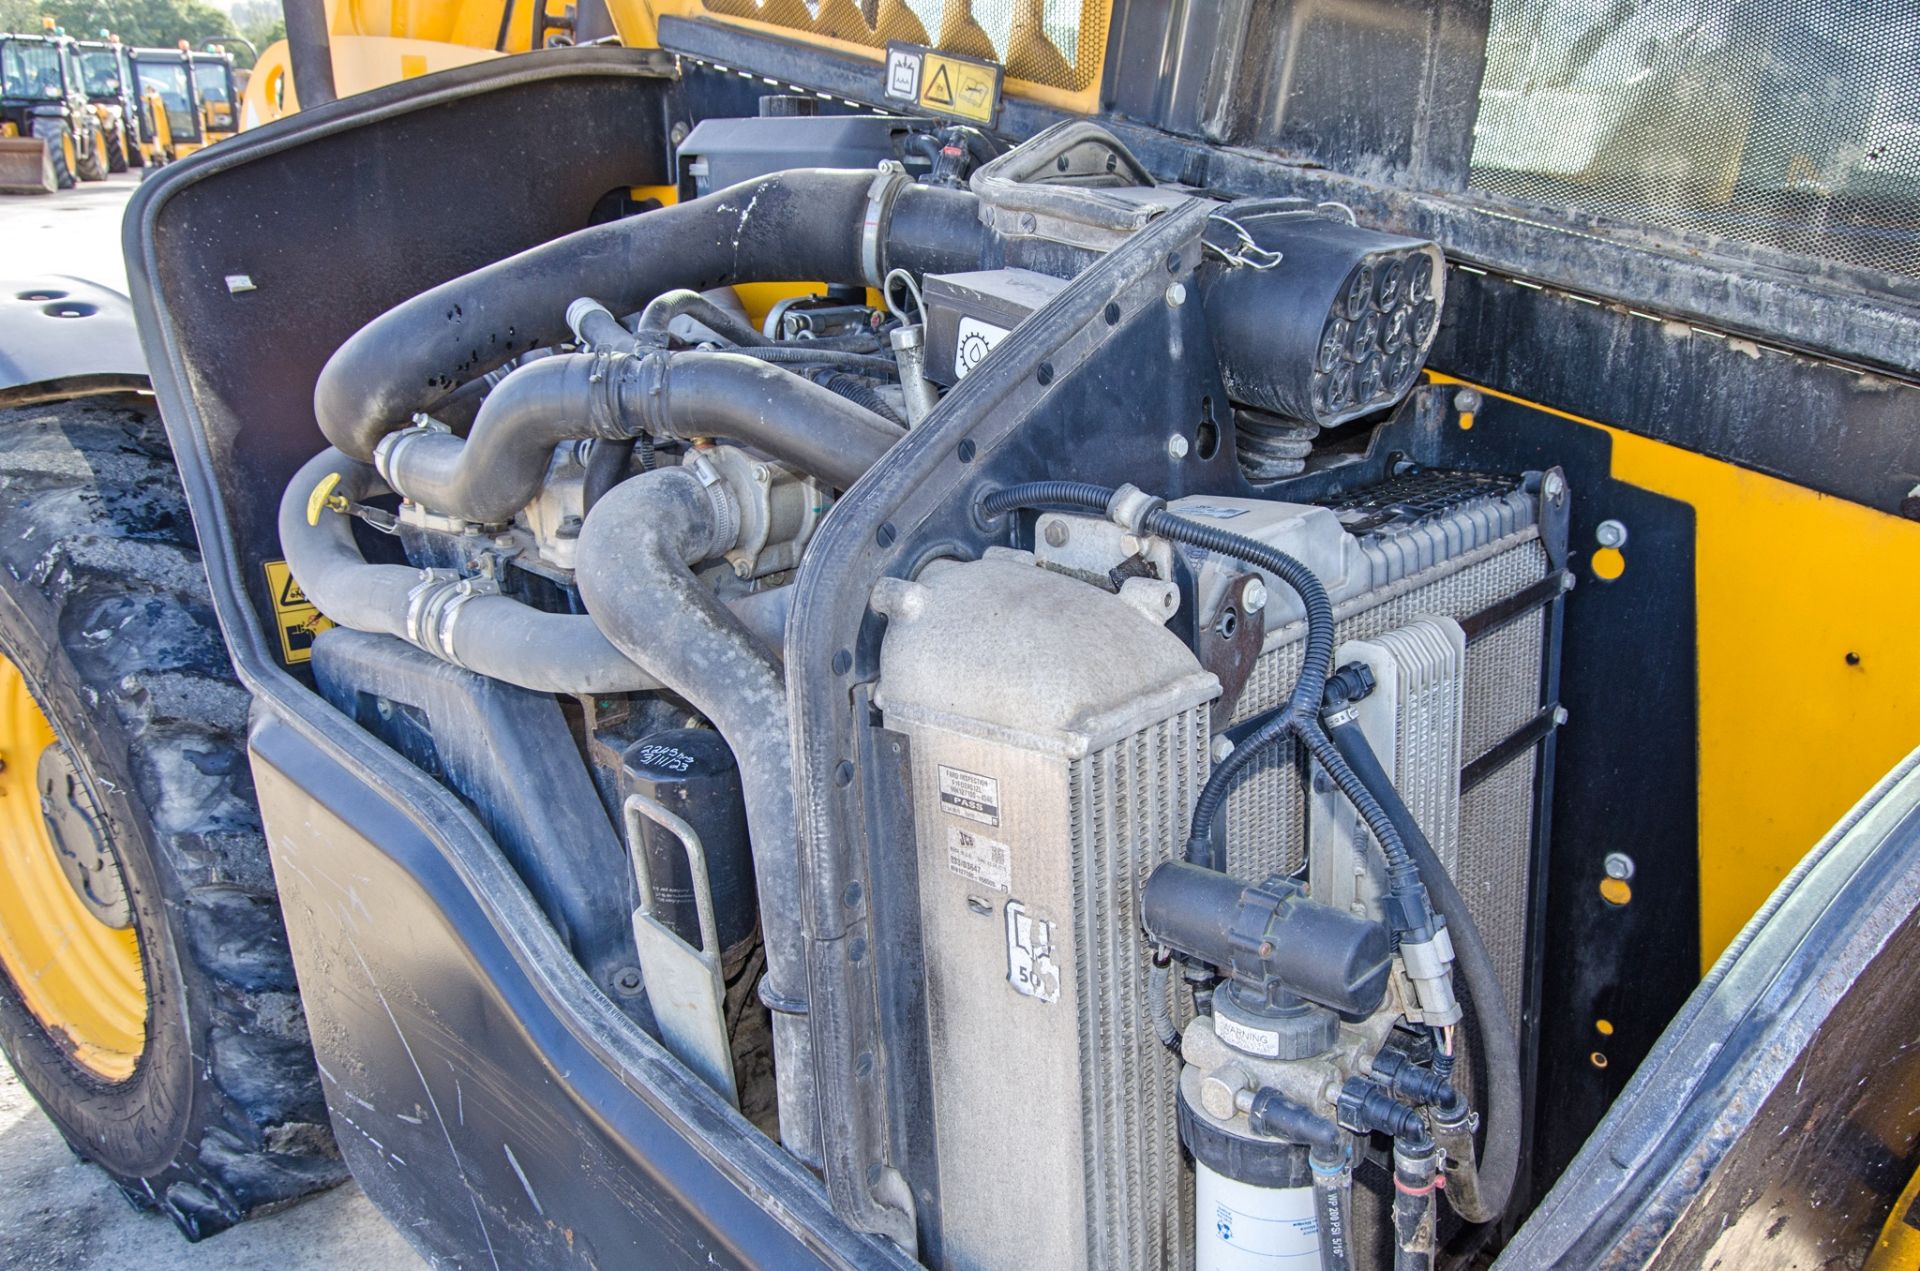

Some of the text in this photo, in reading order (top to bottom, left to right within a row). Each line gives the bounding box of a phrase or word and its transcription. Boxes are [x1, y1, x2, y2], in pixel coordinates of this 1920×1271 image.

[953, 797, 984, 811] PASS
[1327, 1193, 1338, 1206] WP
[1330, 1222, 1341, 1236] PSI
